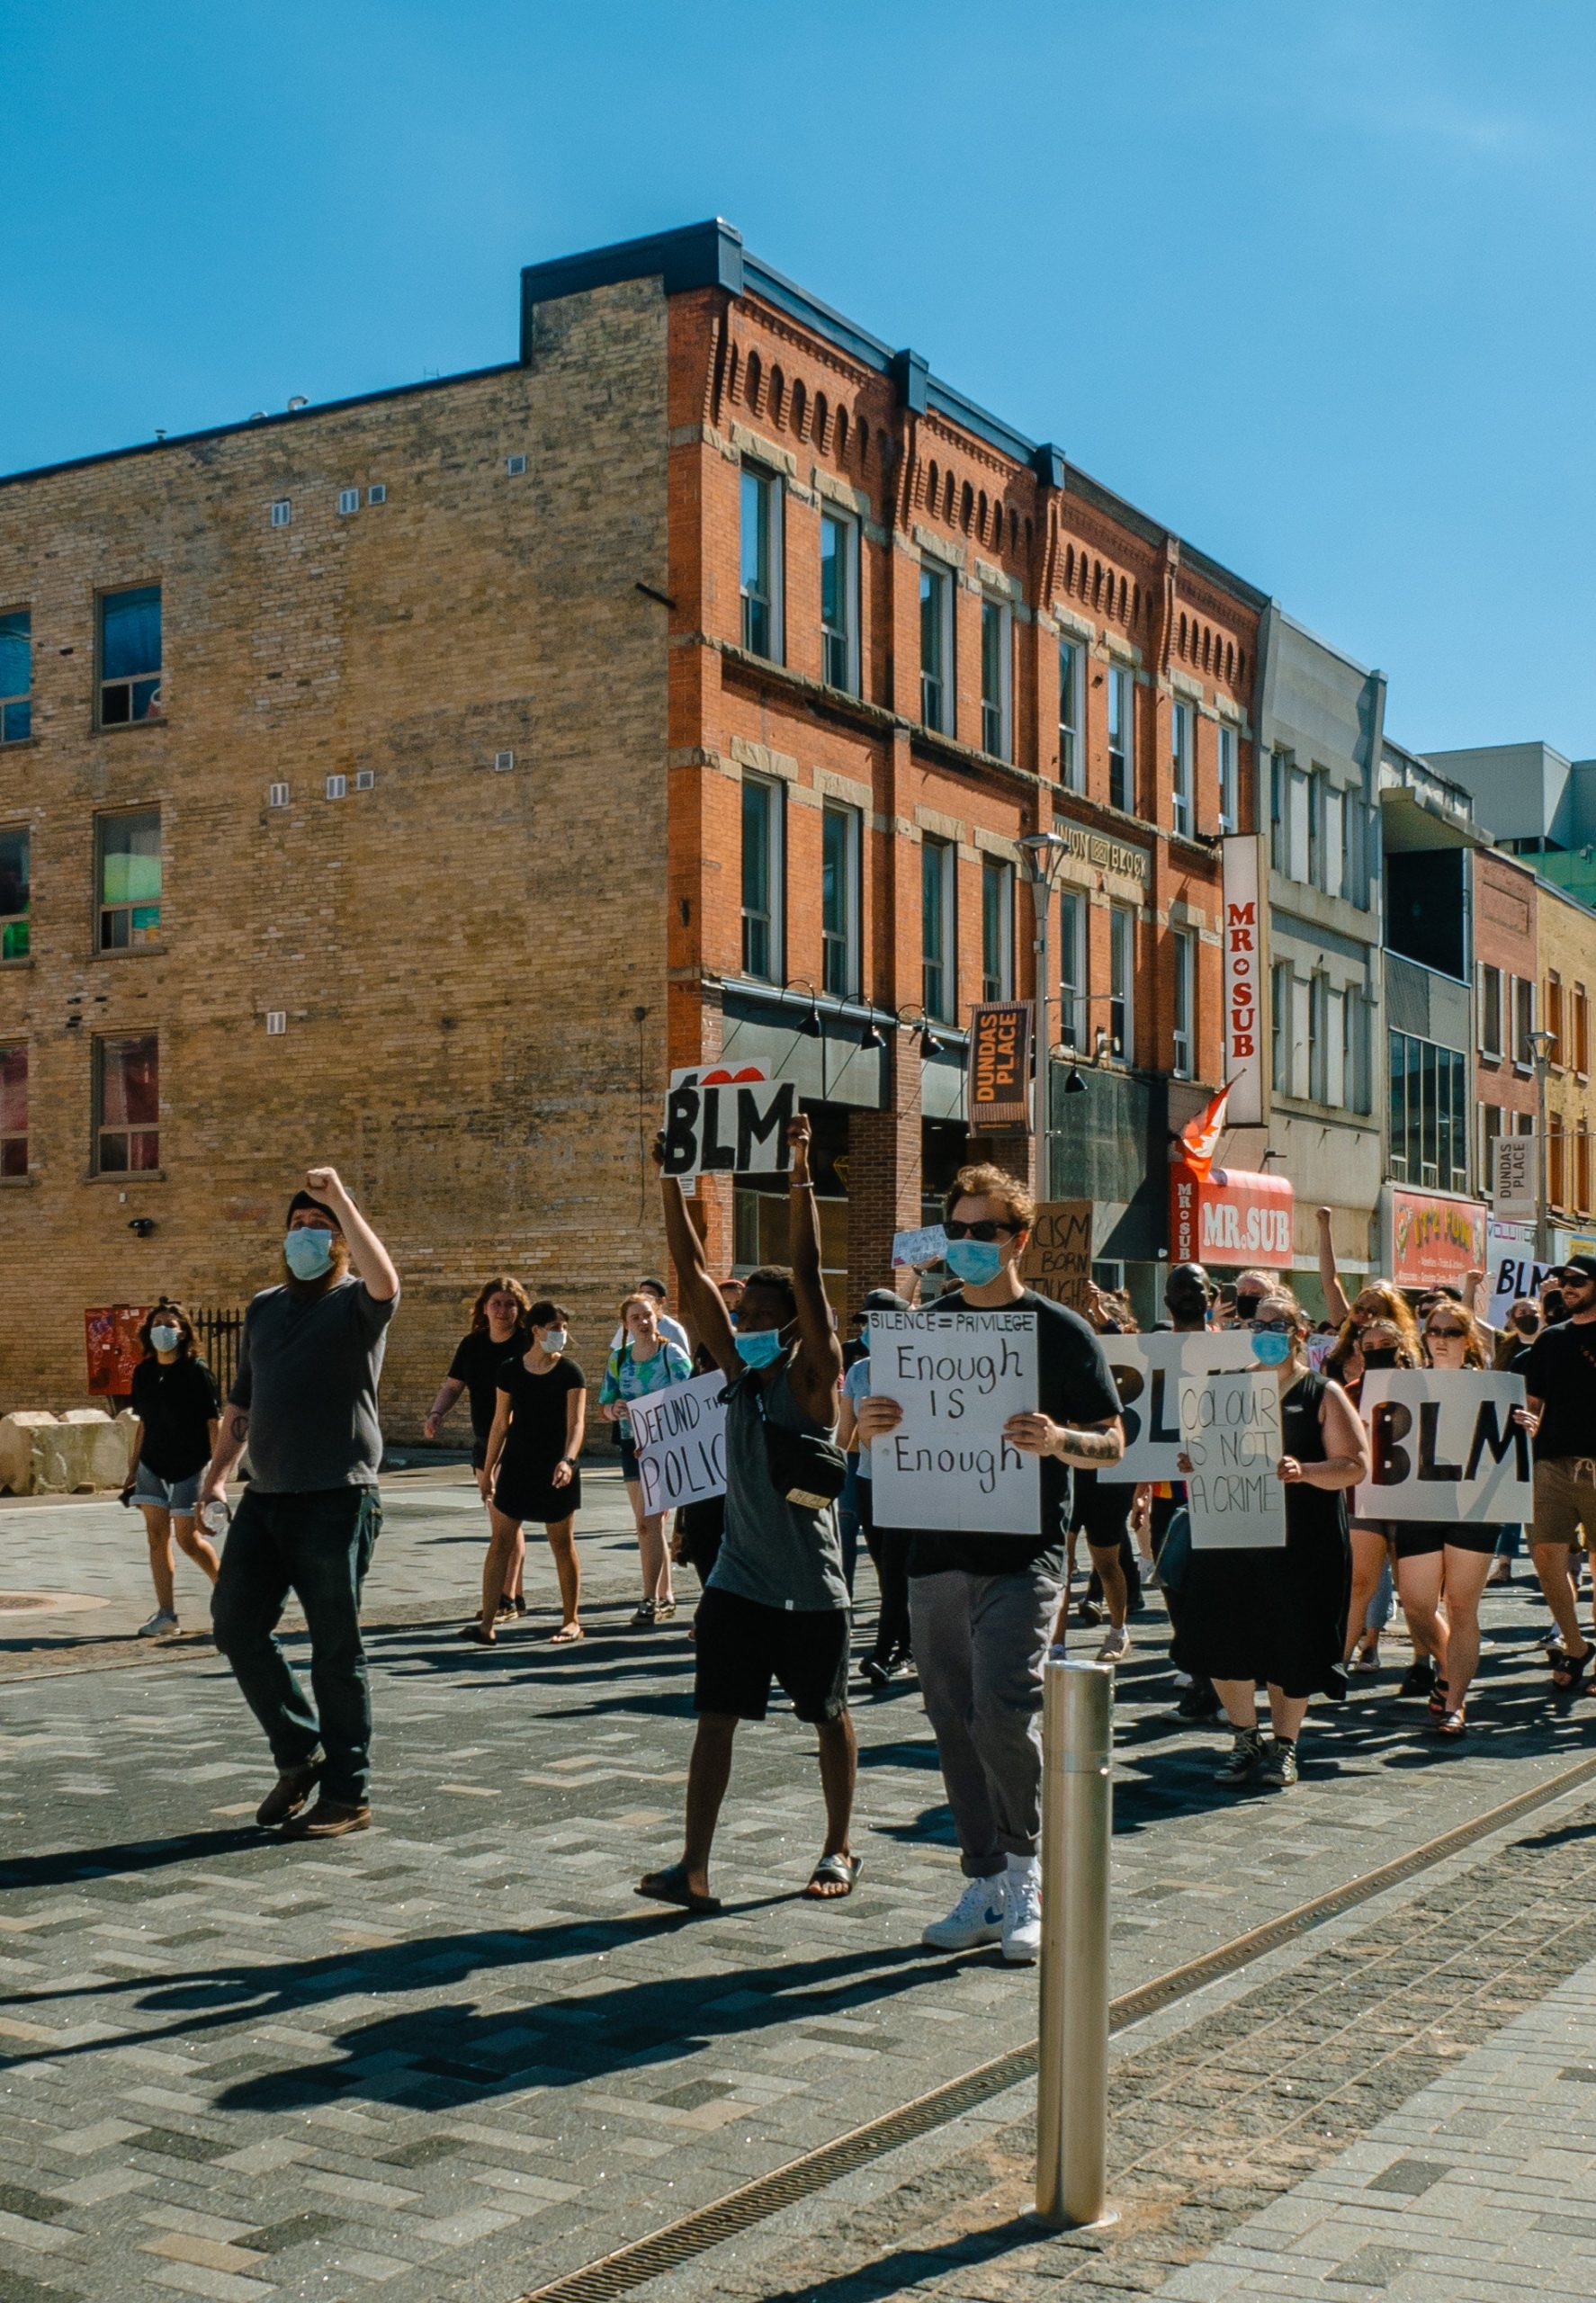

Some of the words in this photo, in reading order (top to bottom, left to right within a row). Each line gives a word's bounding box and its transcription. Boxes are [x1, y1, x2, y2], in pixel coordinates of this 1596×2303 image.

[1112, 845, 1146, 877] BLOCK
[977, 1013, 998, 1101] DUNDAS
[996, 1012, 1018, 1085] PLACE
[664, 1082, 794, 1175] BLM
[1501, 1143, 1511, 1198] DUNDAS
[1513, 1143, 1525, 1188] PLACE
[1032, 1213, 1092, 1250] CISM
[1041, 1250, 1088, 1274] BORN
[896, 1338, 1024, 1394] Enough
[632, 1393, 700, 1453] DEFUND
[704, 1399, 723, 1412] TH
[930, 1388, 964, 1419] IS
[1109, 1364, 1246, 1448] BL
[1181, 1388, 1278, 1430] COLOUR
[641, 1433, 727, 1508] POLIC
[894, 1435, 1024, 1494] Enough
[1186, 1436, 1207, 1466] IS
[1220, 1431, 1277, 1467] NOT
[1371, 1400, 1530, 1486] BLM
[1191, 1474, 1209, 1514] A
[1214, 1472, 1281, 1515] CRIME
